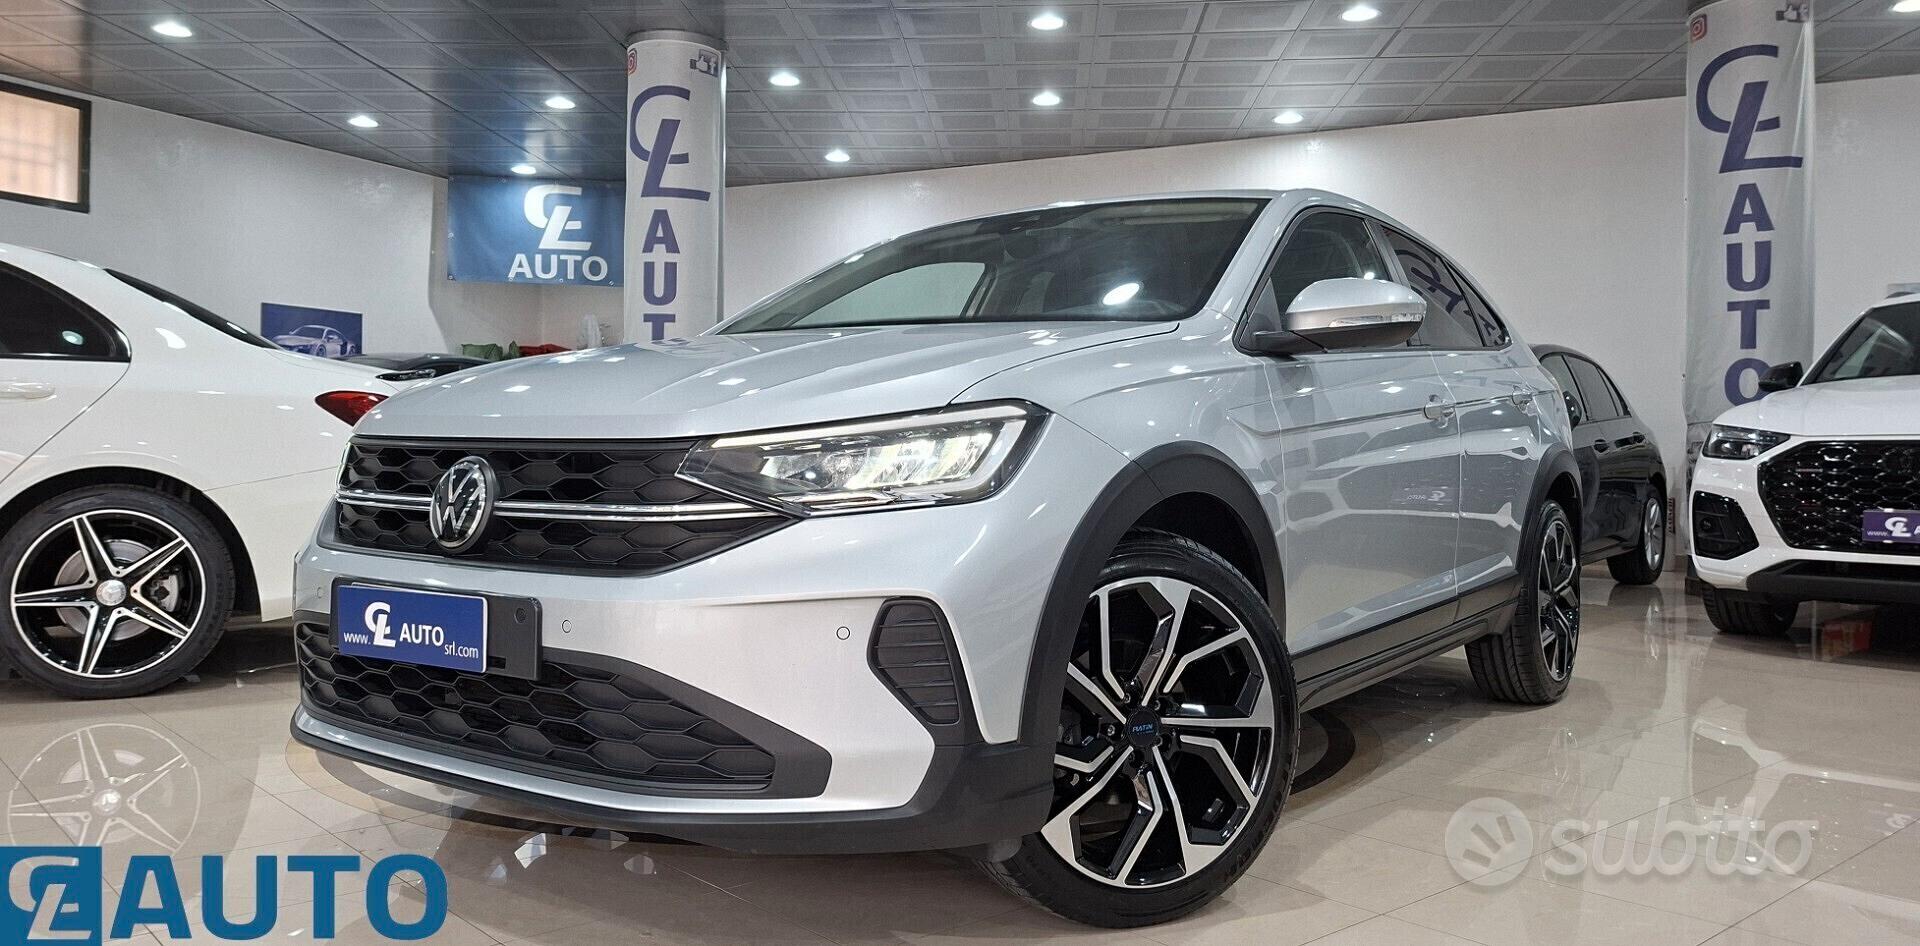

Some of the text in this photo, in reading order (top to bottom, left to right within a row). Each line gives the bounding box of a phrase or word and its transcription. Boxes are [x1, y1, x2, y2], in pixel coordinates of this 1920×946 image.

[508, 253, 608, 281] AUTO
[1723, 183, 1775, 406] AUTO
[343, 632, 371, 645] www.
[400, 623, 445, 647] AUTO
[444, 641, 479, 659] srl.com
